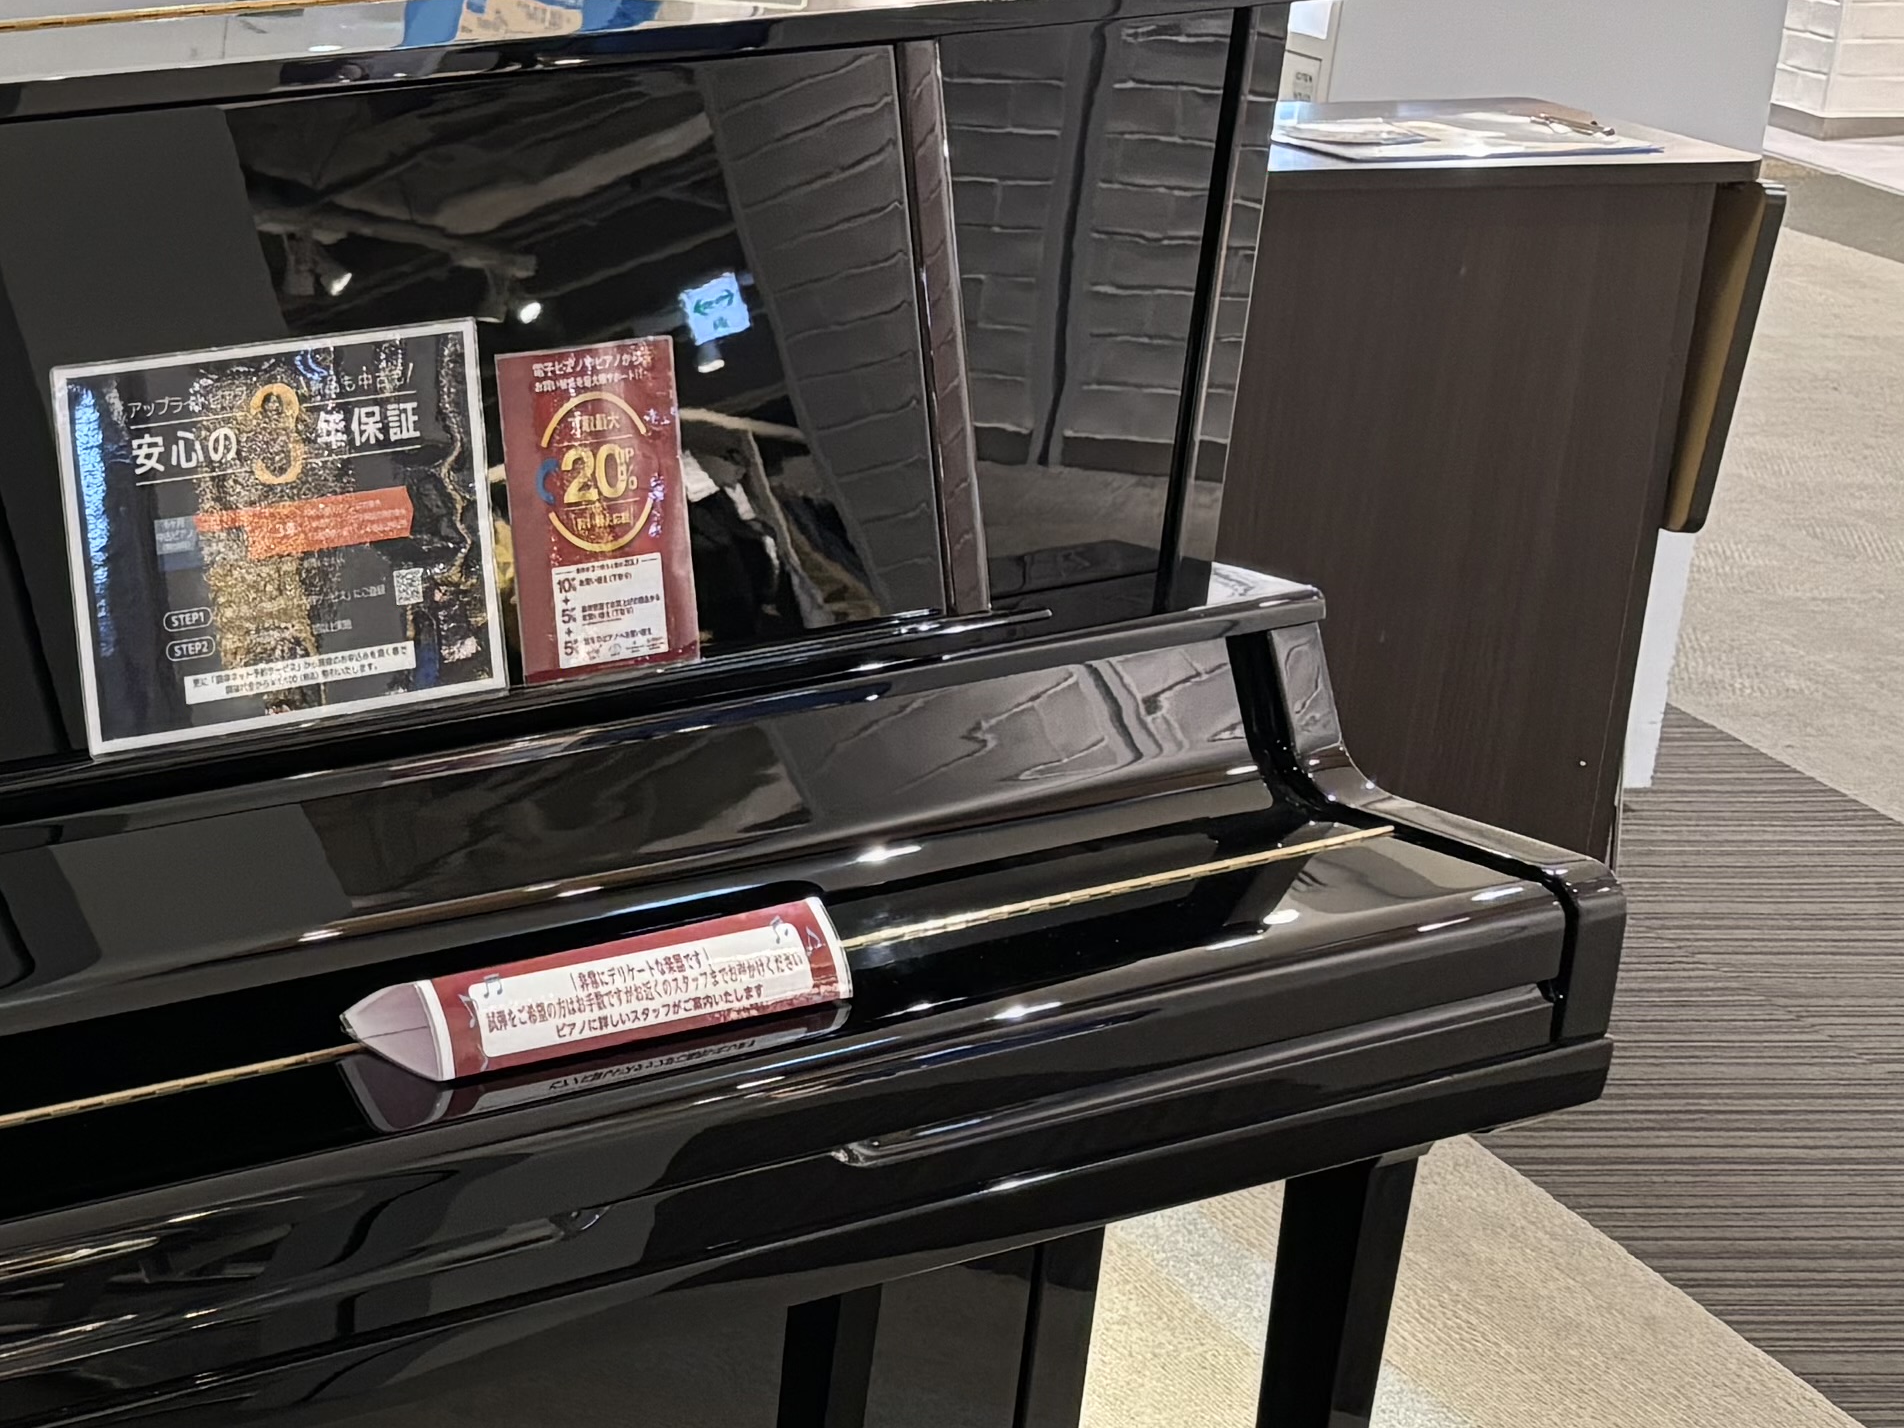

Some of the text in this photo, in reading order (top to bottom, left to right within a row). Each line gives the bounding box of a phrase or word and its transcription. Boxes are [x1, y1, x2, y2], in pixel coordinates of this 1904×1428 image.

[249, 382, 305, 486] 3
[315, 401, 422, 450] 年保証
[130, 426, 238, 475] 安心の
[561, 443, 628, 505] 20
[171, 613, 207, 627] STEP1
[173, 641, 209, 655] STEP2
[555, 982, 765, 1039] ピアノに詳しいスタッフがご案内いたします
